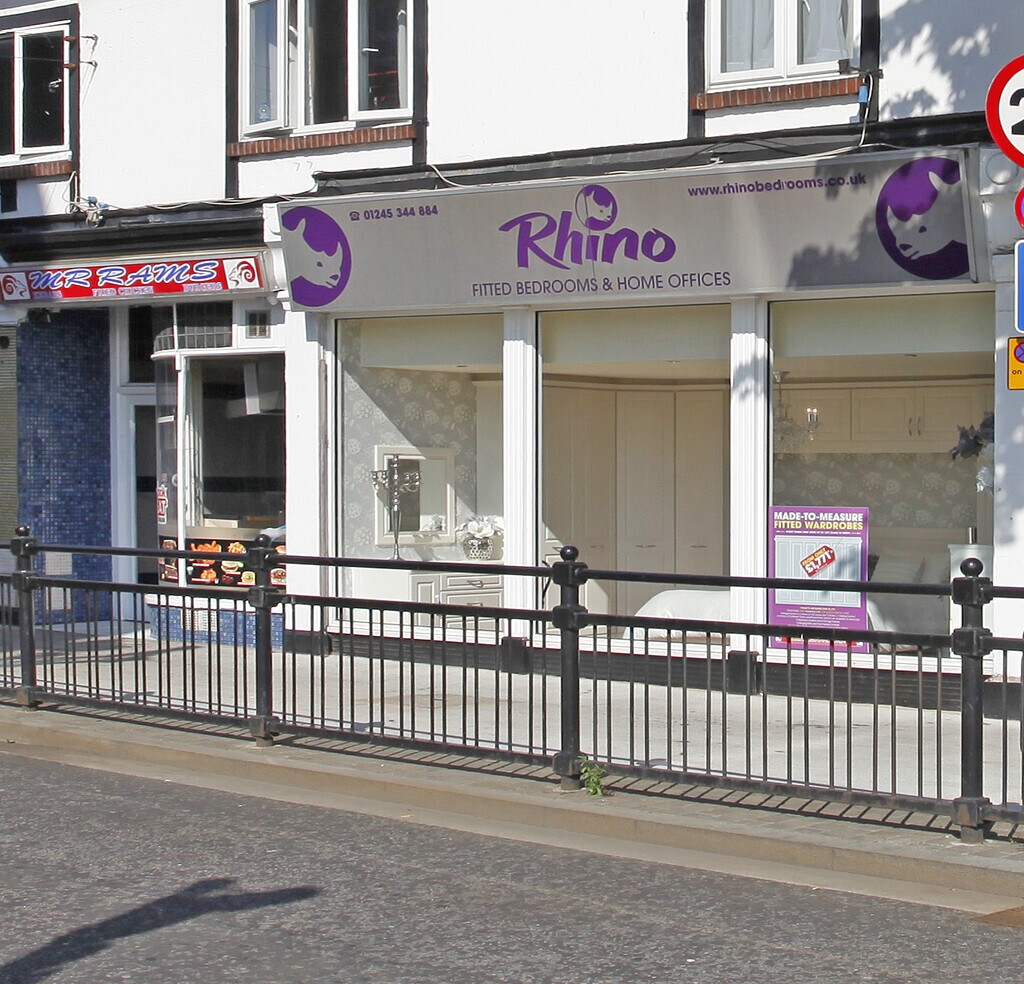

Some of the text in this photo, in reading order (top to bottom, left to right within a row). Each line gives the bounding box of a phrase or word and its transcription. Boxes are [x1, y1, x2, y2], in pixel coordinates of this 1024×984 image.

[688, 173, 867, 197] www.rhinobedrooms.co.uk
[364, 205, 438, 220] 01245 344 884
[498, 211, 677, 270] Rhino
[29, 262, 219, 290] MR RAMS
[472, 271, 731, 297] FITTED BEDROOMS & HOME OFFICES
[774, 511, 863, 521] MADE-TO-MEASURE
[774, 520, 863, 530] FITTED WARDROBES
